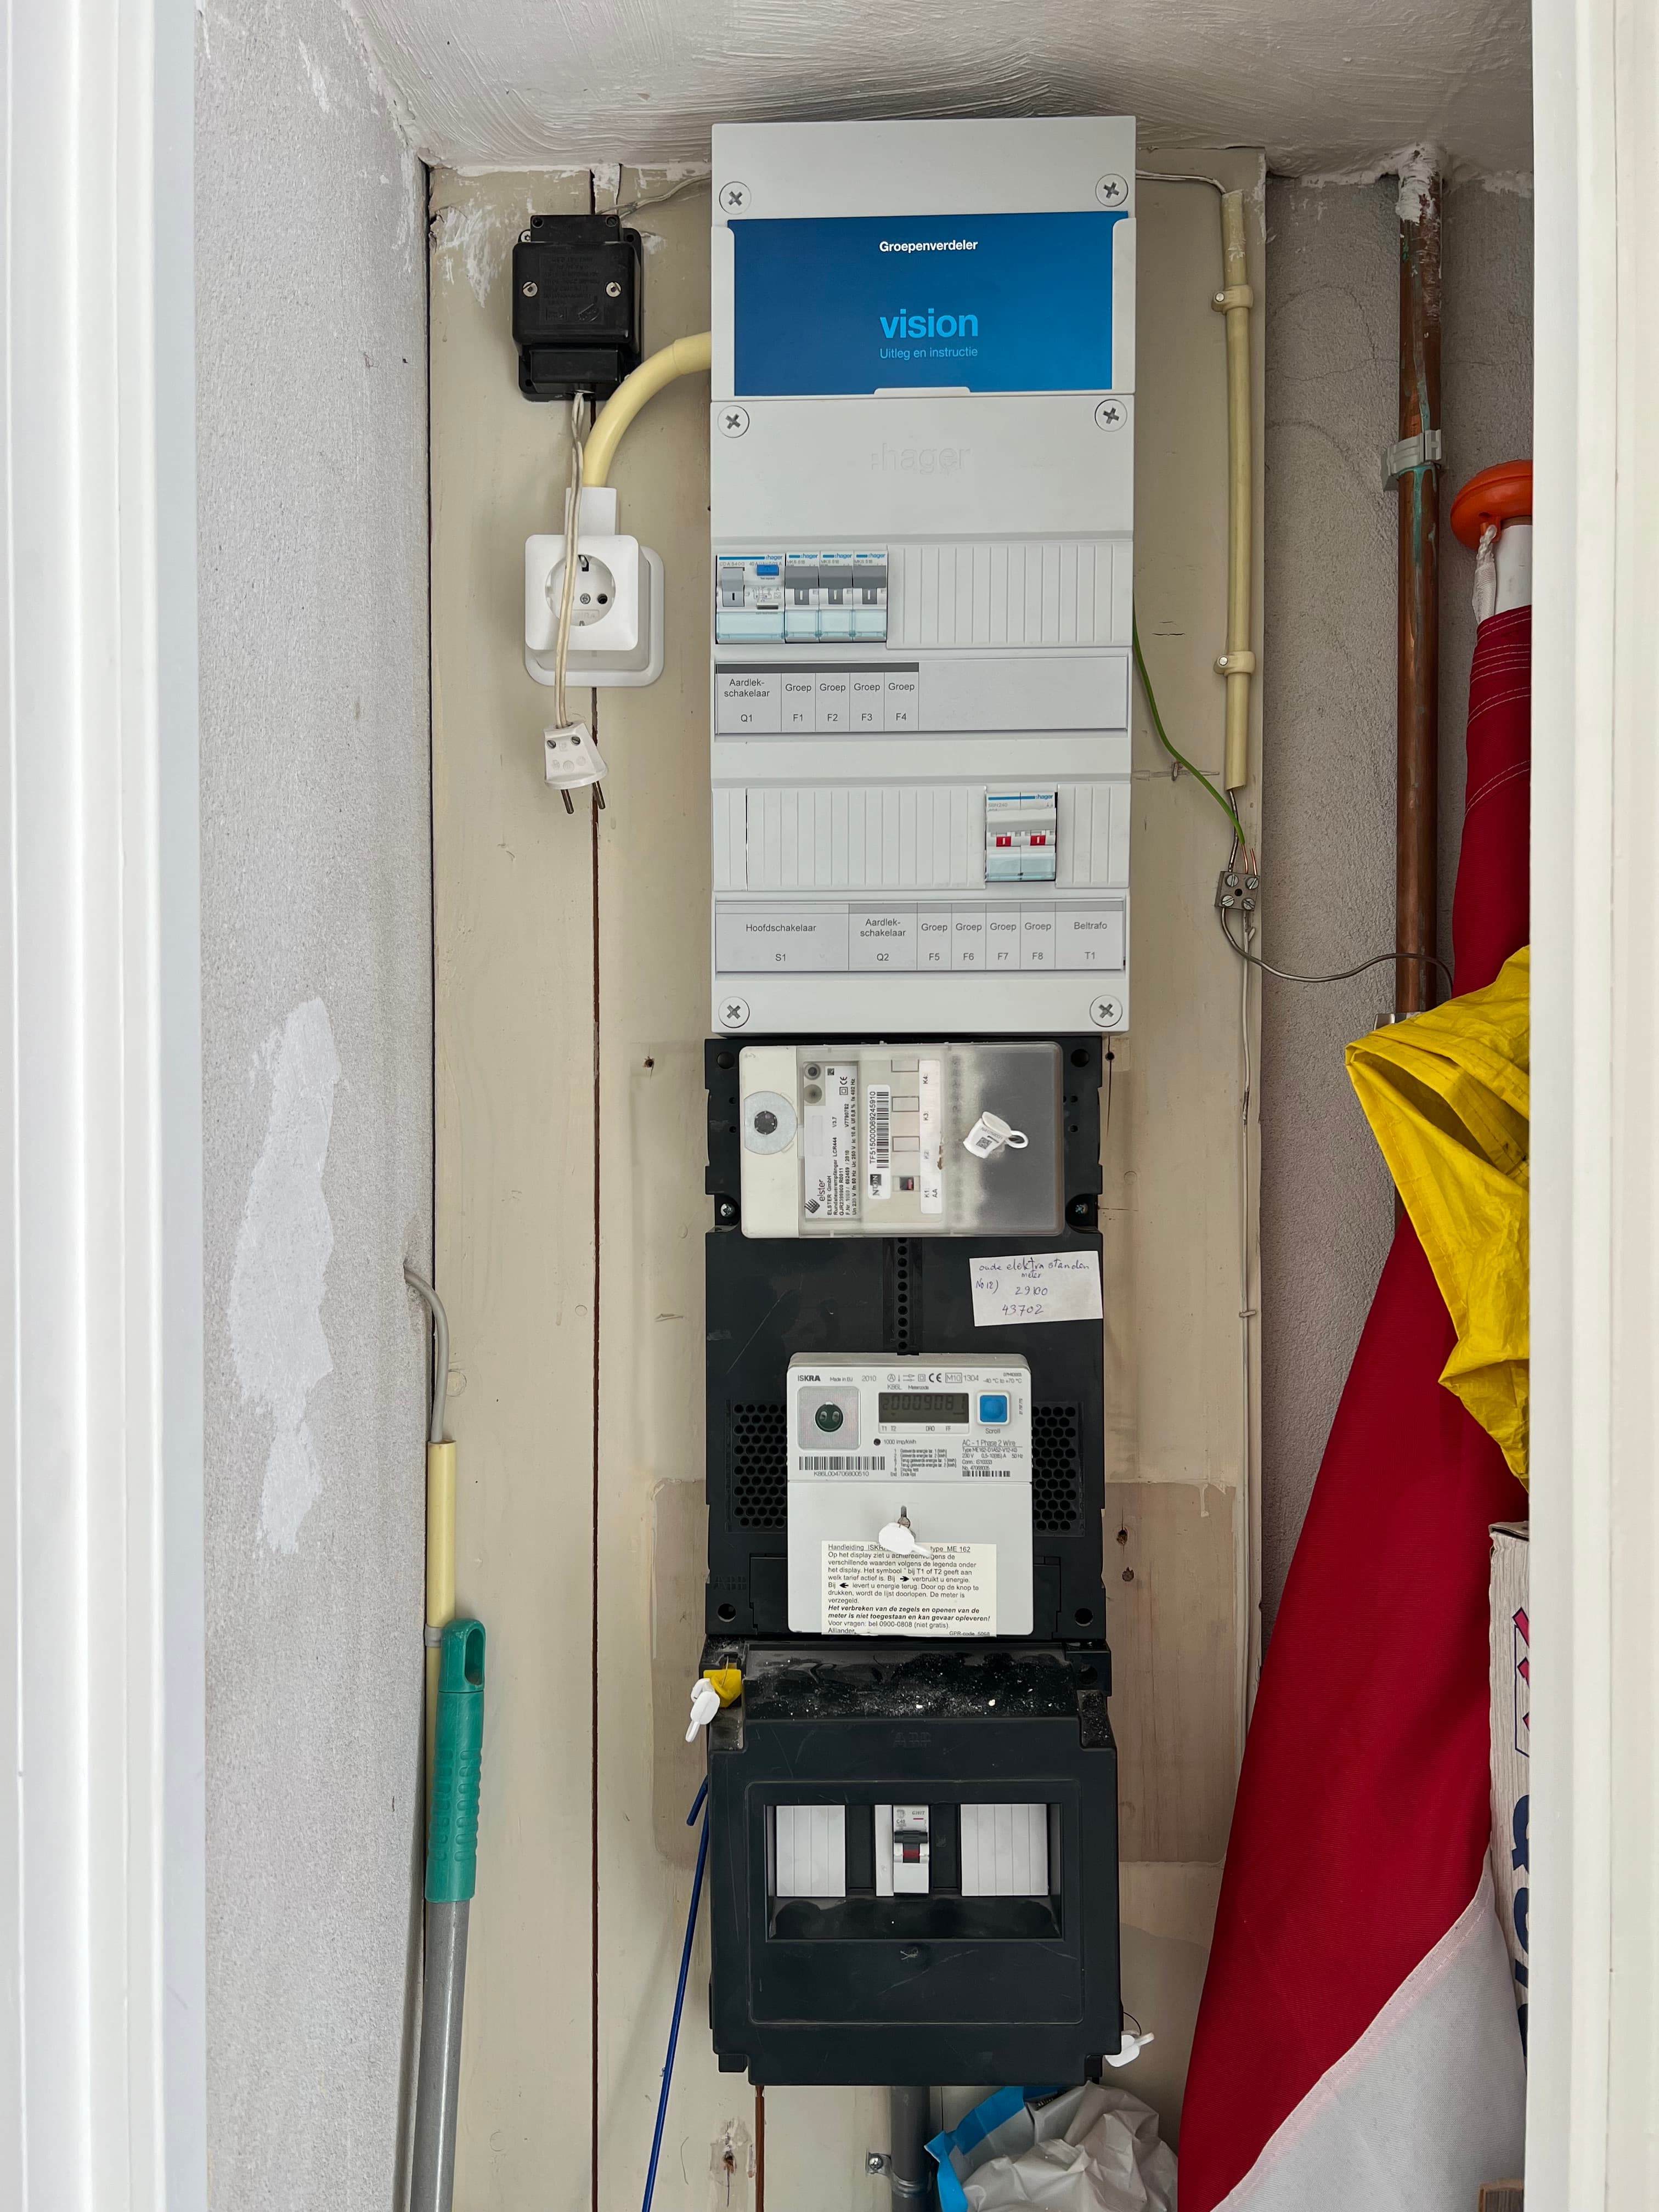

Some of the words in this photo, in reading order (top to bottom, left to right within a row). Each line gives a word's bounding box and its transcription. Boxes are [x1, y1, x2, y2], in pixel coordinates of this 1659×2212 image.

[879, 240, 978, 253] Groepenverdeler
[880, 309, 979, 338] vision
[880, 348, 910, 360] Uitleg
[913, 349, 926, 358] en
[929, 347, 978, 358] instructie
[786, 684, 811, 692] Groep
[820, 684, 845, 692] Groep
[854, 683, 880, 692] Groep
[888, 682, 915, 691] Groep
[865, 918, 900, 927] Aardlek-
[1025, 922, 1051, 932] Groep
[1074, 921, 1108, 930] Beltrafo
[746, 923, 816, 933] Hoofdschakelaar
[860, 928, 906, 937] schakelaar
[921, 923, 948, 933] Groep
[956, 923, 982, 933] Groep
[990, 923, 1017, 933] Groep
[877, 953, 889, 962] Q2
[997, 952, 1008, 961] F7
[817, 1179, 825, 1201] elster
[1007, 1257, 1044, 1271] elektra
[1002, 1304, 1043, 1316] 43702
